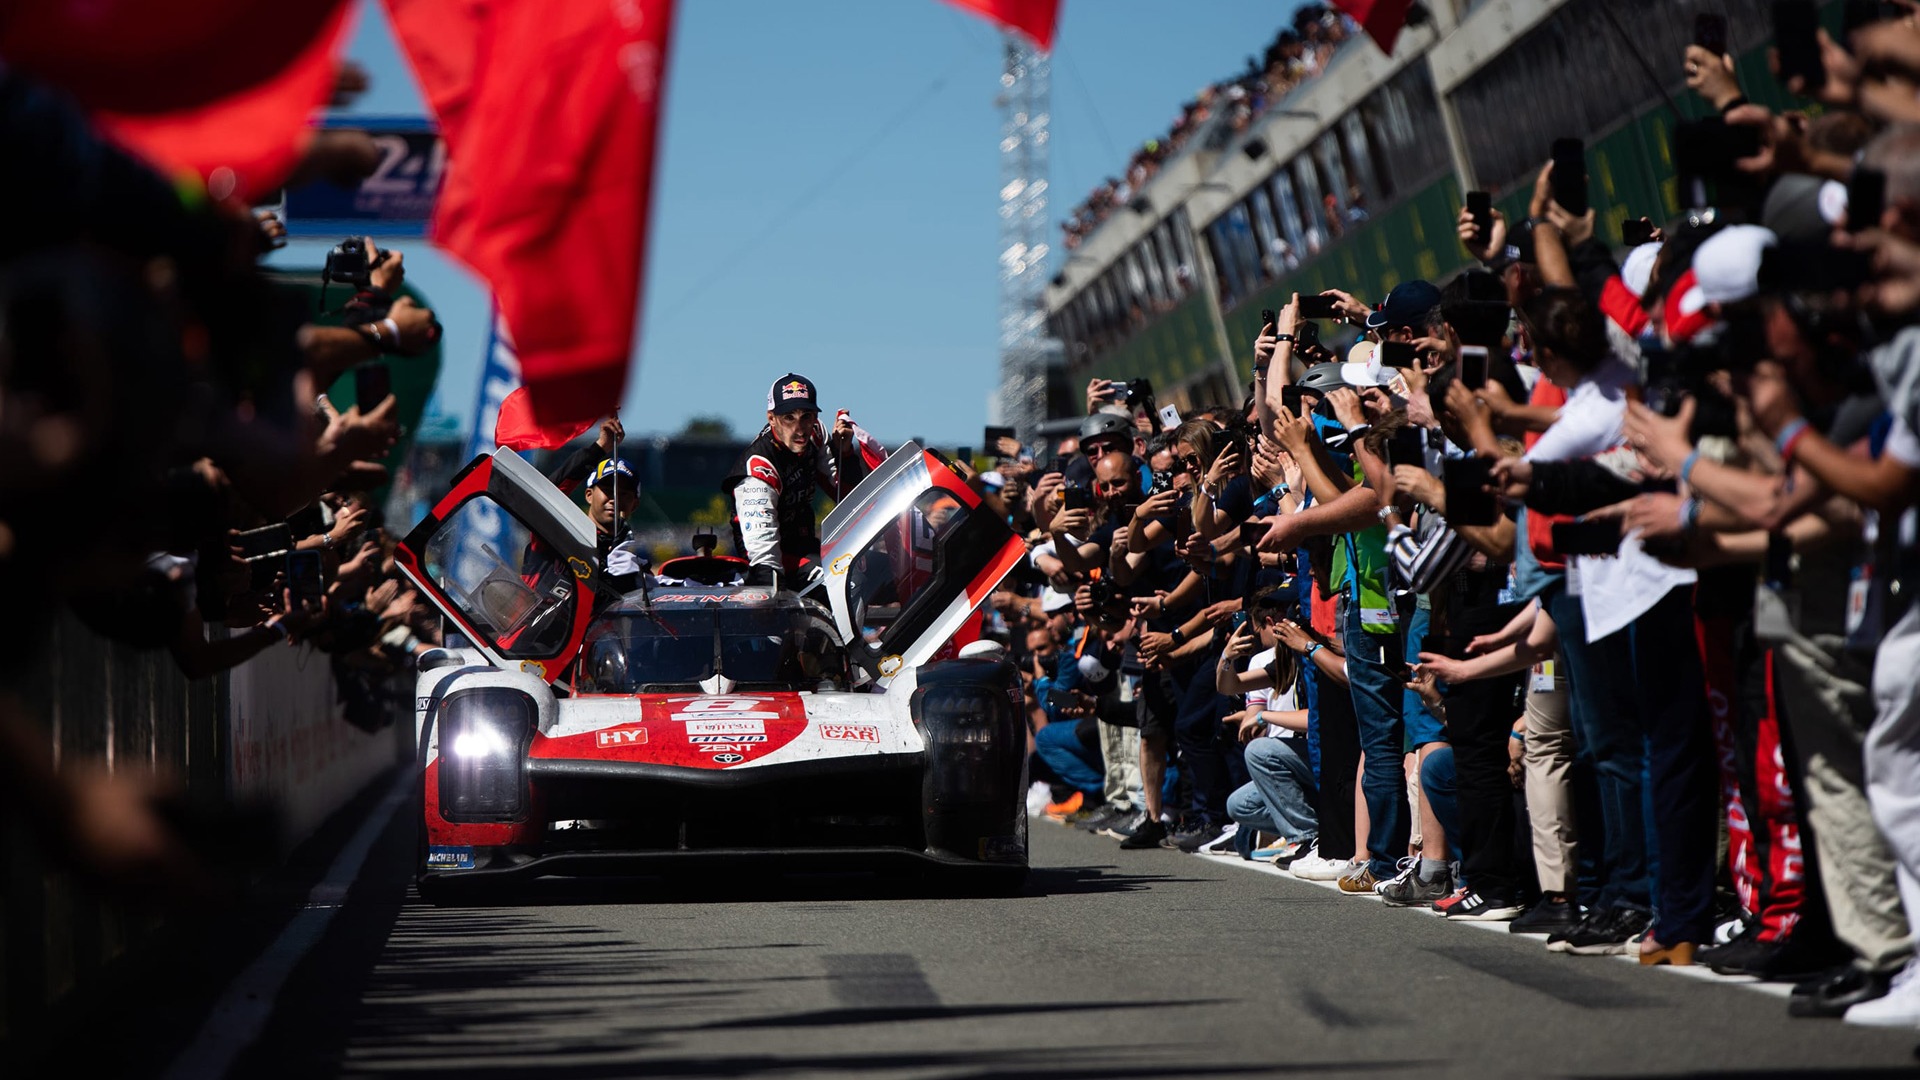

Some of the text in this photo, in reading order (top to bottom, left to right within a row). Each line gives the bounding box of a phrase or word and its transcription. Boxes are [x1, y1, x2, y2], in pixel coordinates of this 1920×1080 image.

[651, 594, 770, 603] DENSO
[600, 730, 640, 745] HY
[825, 729, 875, 742] CAR
[699, 744, 757, 753] ZENT
[428, 852, 470, 863] MICHELIN
